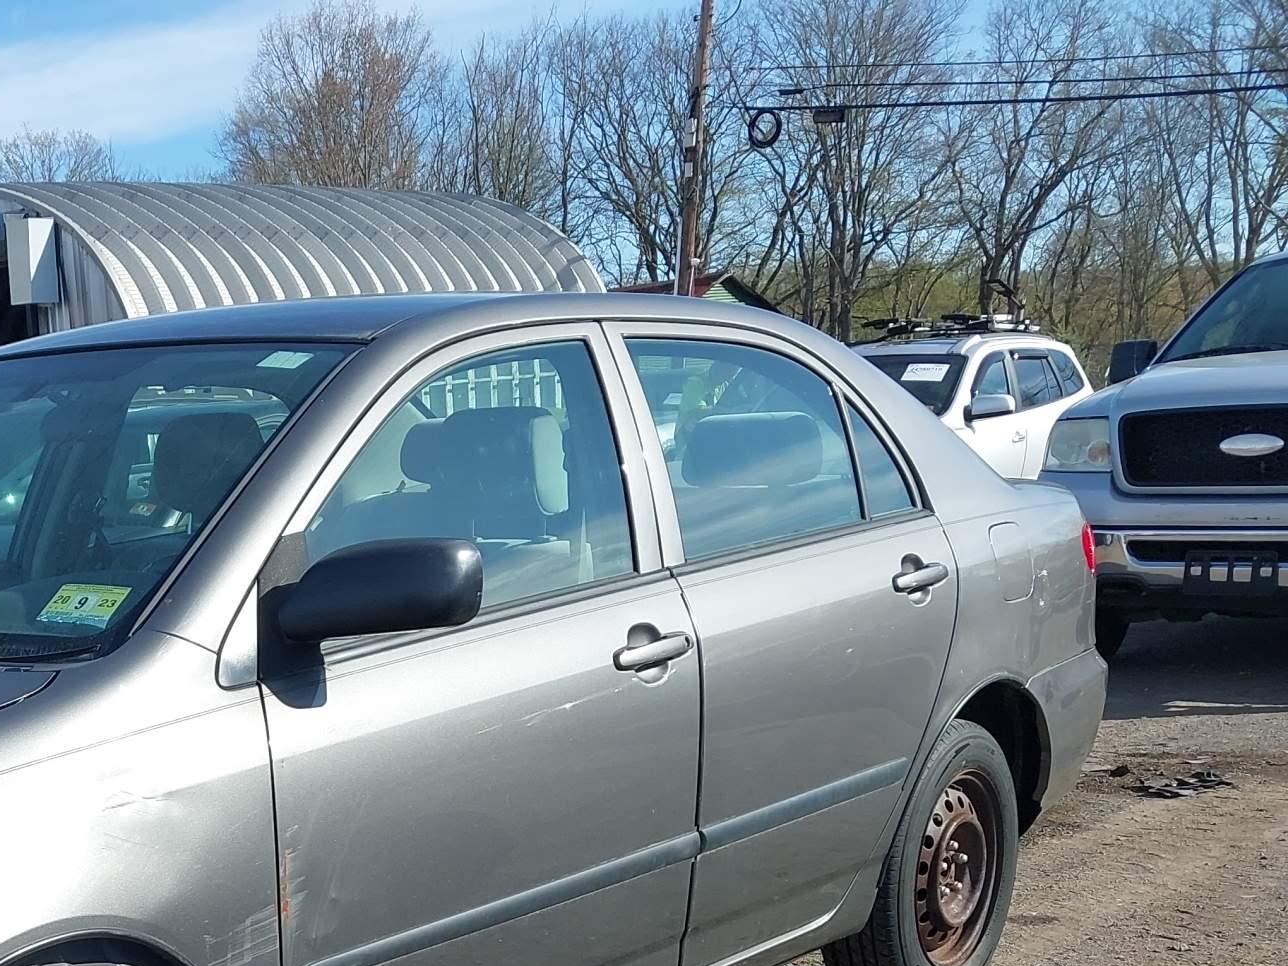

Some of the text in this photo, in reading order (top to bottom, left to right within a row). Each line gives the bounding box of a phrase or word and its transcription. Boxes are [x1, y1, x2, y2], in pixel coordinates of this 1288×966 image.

[53, 595, 118, 610] 20 9 23
